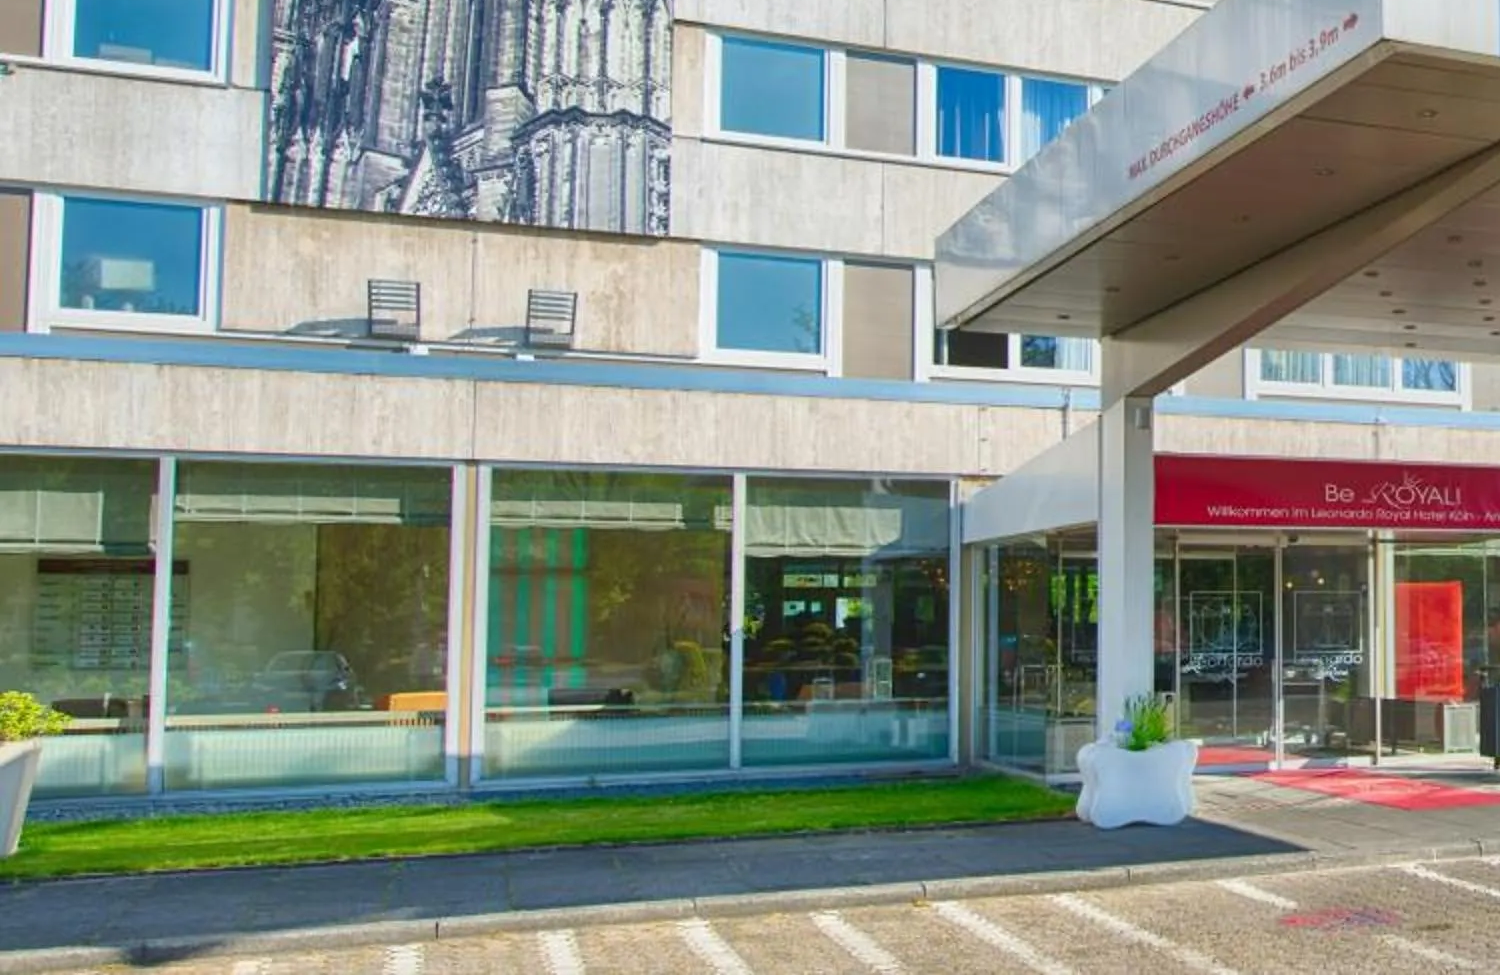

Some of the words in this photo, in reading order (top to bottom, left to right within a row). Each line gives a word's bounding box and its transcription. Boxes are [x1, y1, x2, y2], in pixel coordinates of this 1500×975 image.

[1289, 48, 1306, 72] bis
[1325, 484, 1355, 503] Be
[1207, 505, 1289, 519] Willkommen
[1292, 506, 1309, 519] im
[1311, 507, 1374, 520] Leonardo
[1375, 508, 1411, 523] Royal
[1413, 510, 1446, 522] Hotel
[1448, 509, 1474, 522] Köln
